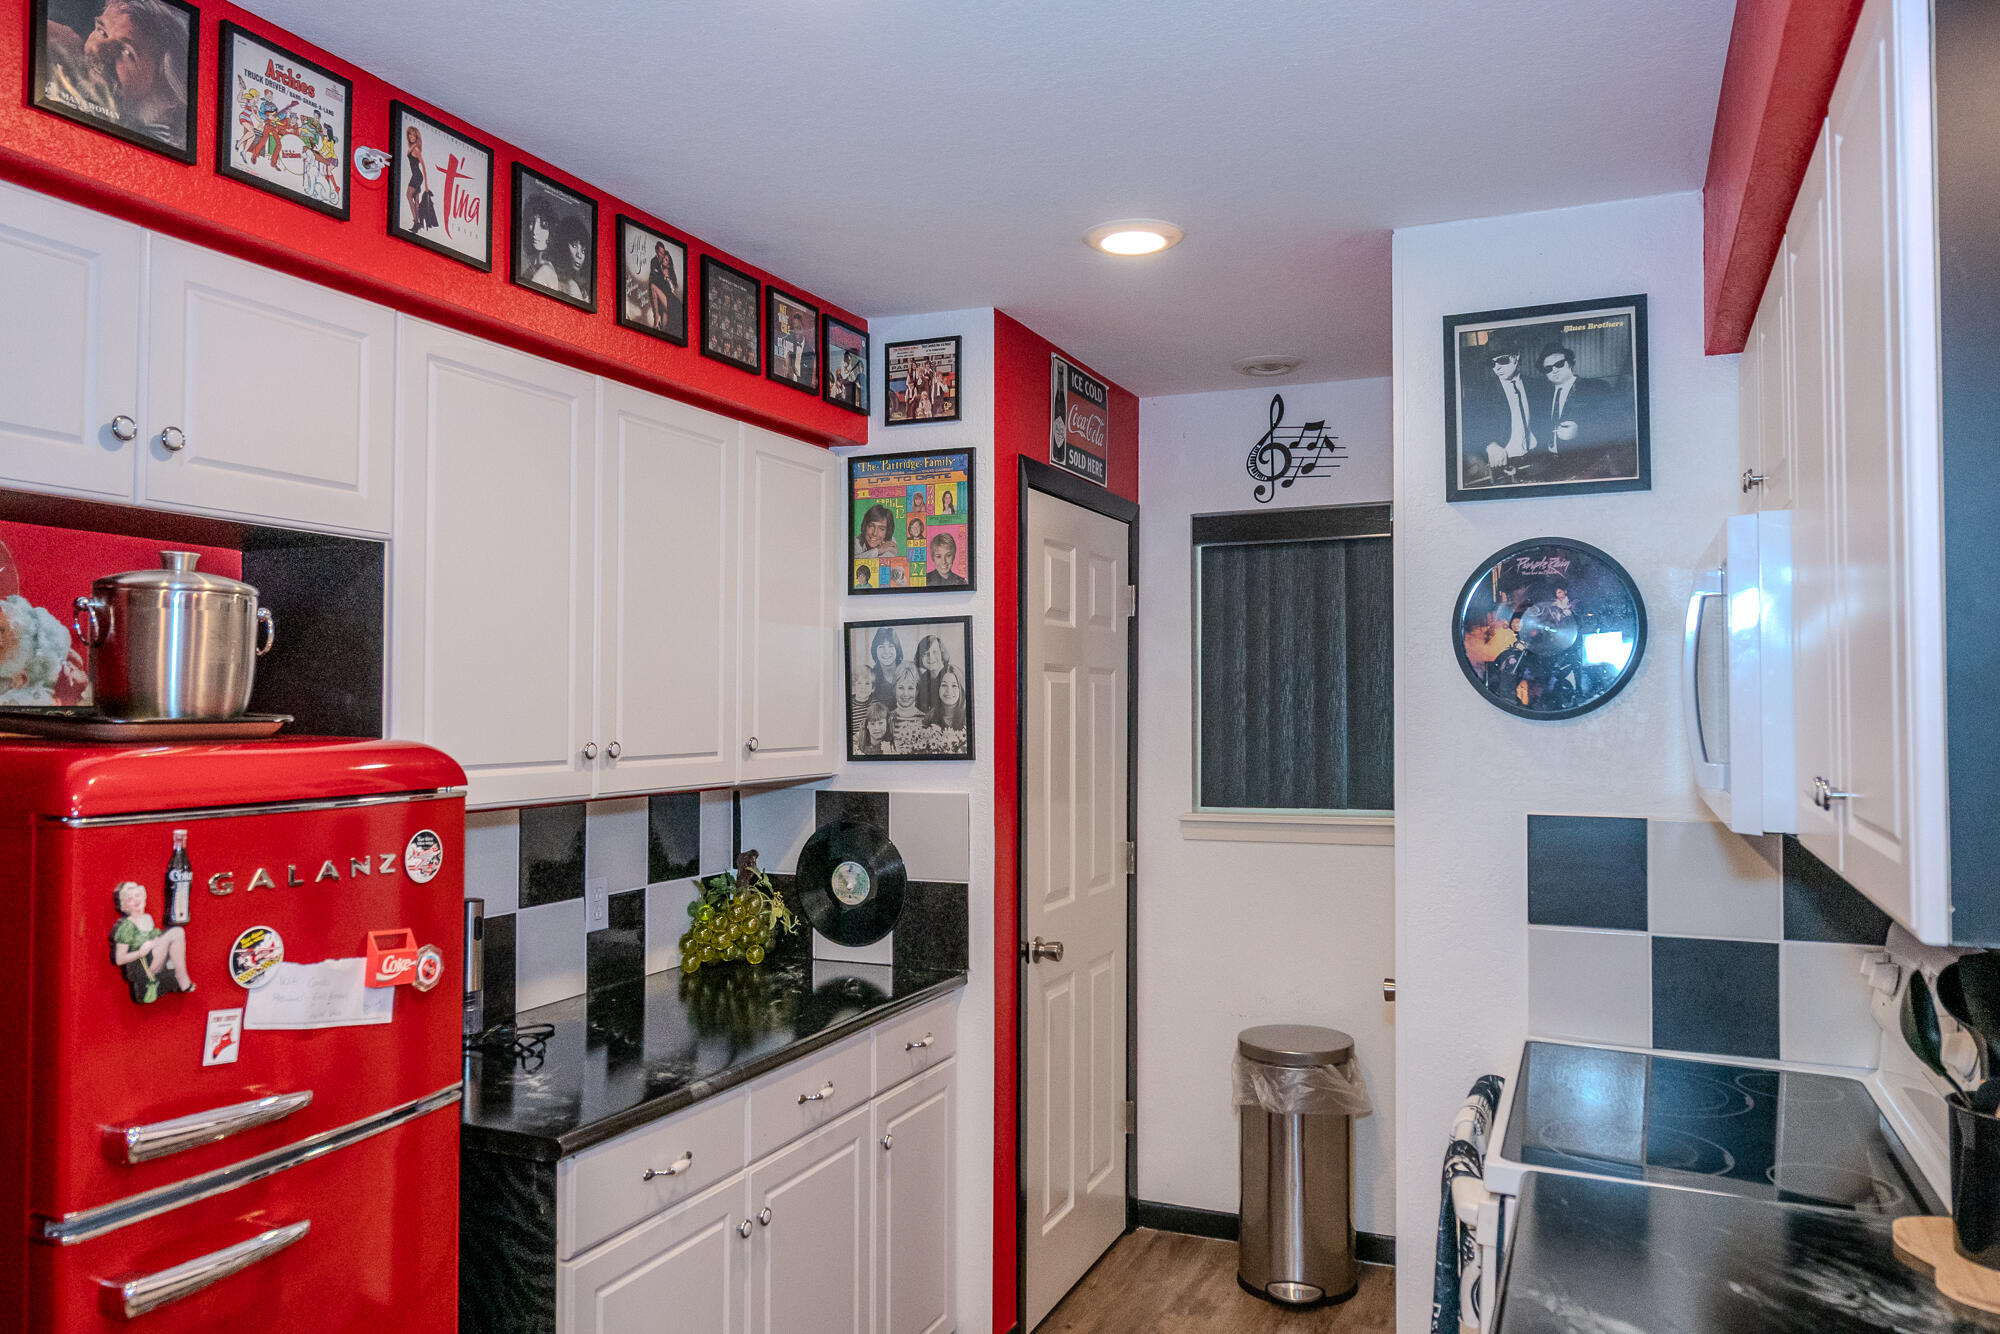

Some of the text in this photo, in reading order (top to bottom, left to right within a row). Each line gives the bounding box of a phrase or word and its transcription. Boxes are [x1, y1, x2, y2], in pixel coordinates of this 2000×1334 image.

[244, 68, 264, 84] TRUCK
[265, 58, 316, 98] Archies
[1563, 322, 1624, 333] Blues Brothers
[1071, 372, 1103, 403] ICE COLD
[858, 456, 955, 472] The Partridge Family
[1068, 449, 1103, 478] SOLD HERE
[208, 853, 397, 896] GALANZ
[376, 954, 417, 981] Coke
